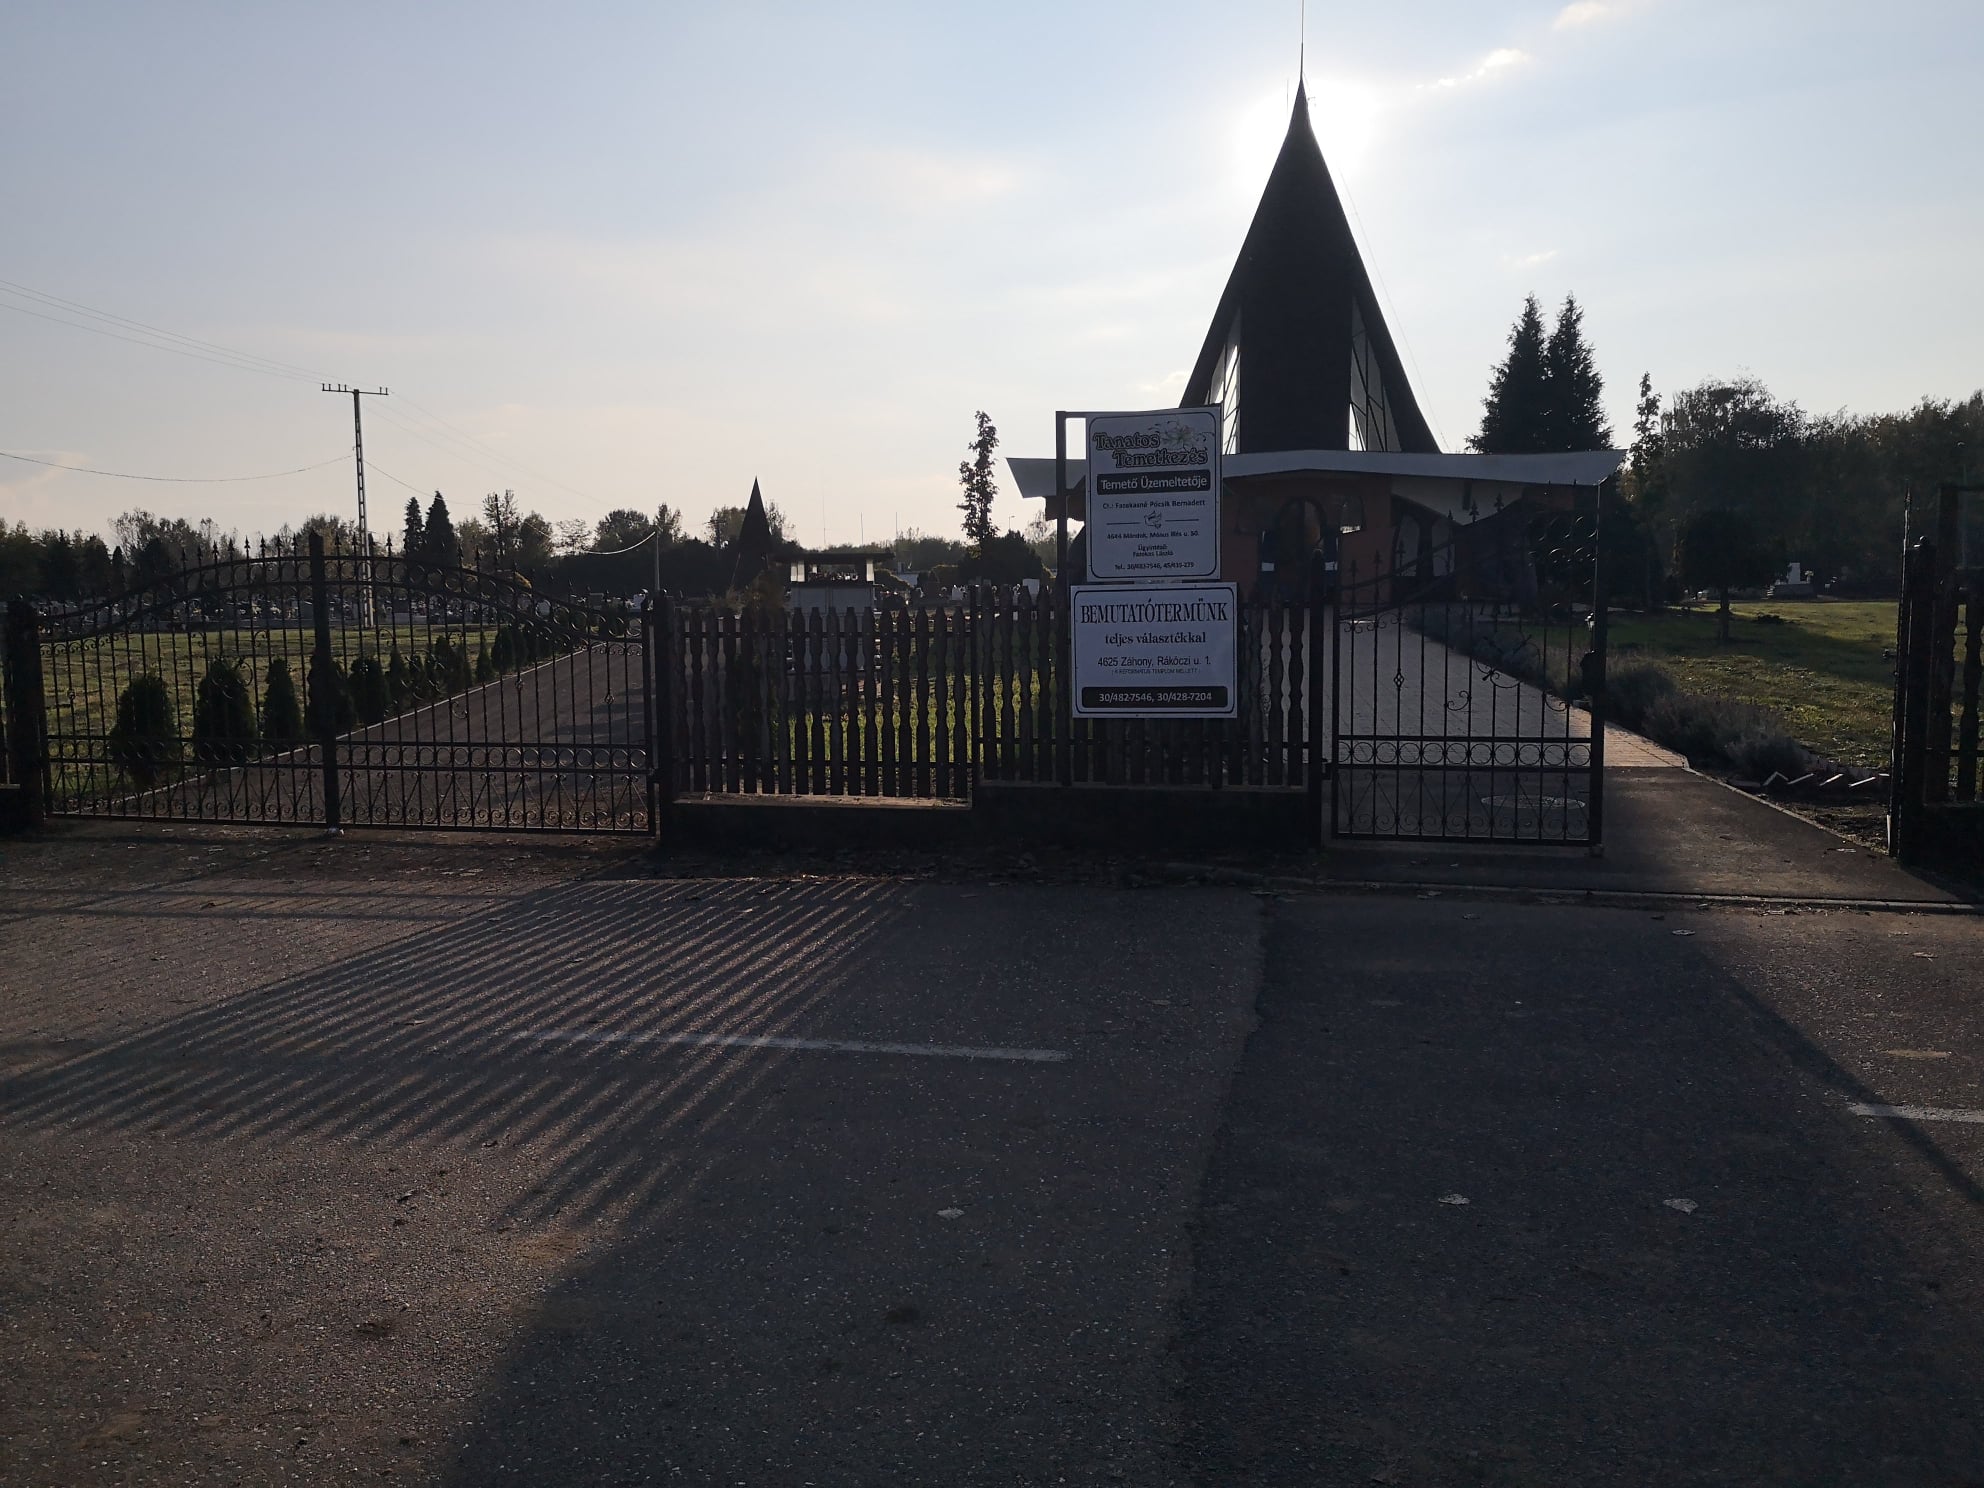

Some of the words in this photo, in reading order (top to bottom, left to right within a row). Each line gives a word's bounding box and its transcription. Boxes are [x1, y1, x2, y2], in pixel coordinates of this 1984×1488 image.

[1093, 432, 1161, 451] Tanatos
[1112, 447, 1208, 468] Temetkezés
[1101, 477, 1138, 490] Temető
[1140, 475, 1208, 489] Üzemeltetője
[1080, 598, 1228, 624] BEMUTATÓTERMÜNK
[1105, 632, 1134, 647] teljes
[1136, 631, 1206, 644] választékkal
[1098, 657, 1118, 667] 4625
[1121, 656, 1154, 668] Záhony,
[1157, 655, 1191, 666] Rákóczi
[1193, 657, 1201, 666] u.
[1205, 656, 1211, 665] 1.
[1099, 692, 1155, 703] 30/482-7546,
[1157, 692, 1212, 703] 30/428-7204
